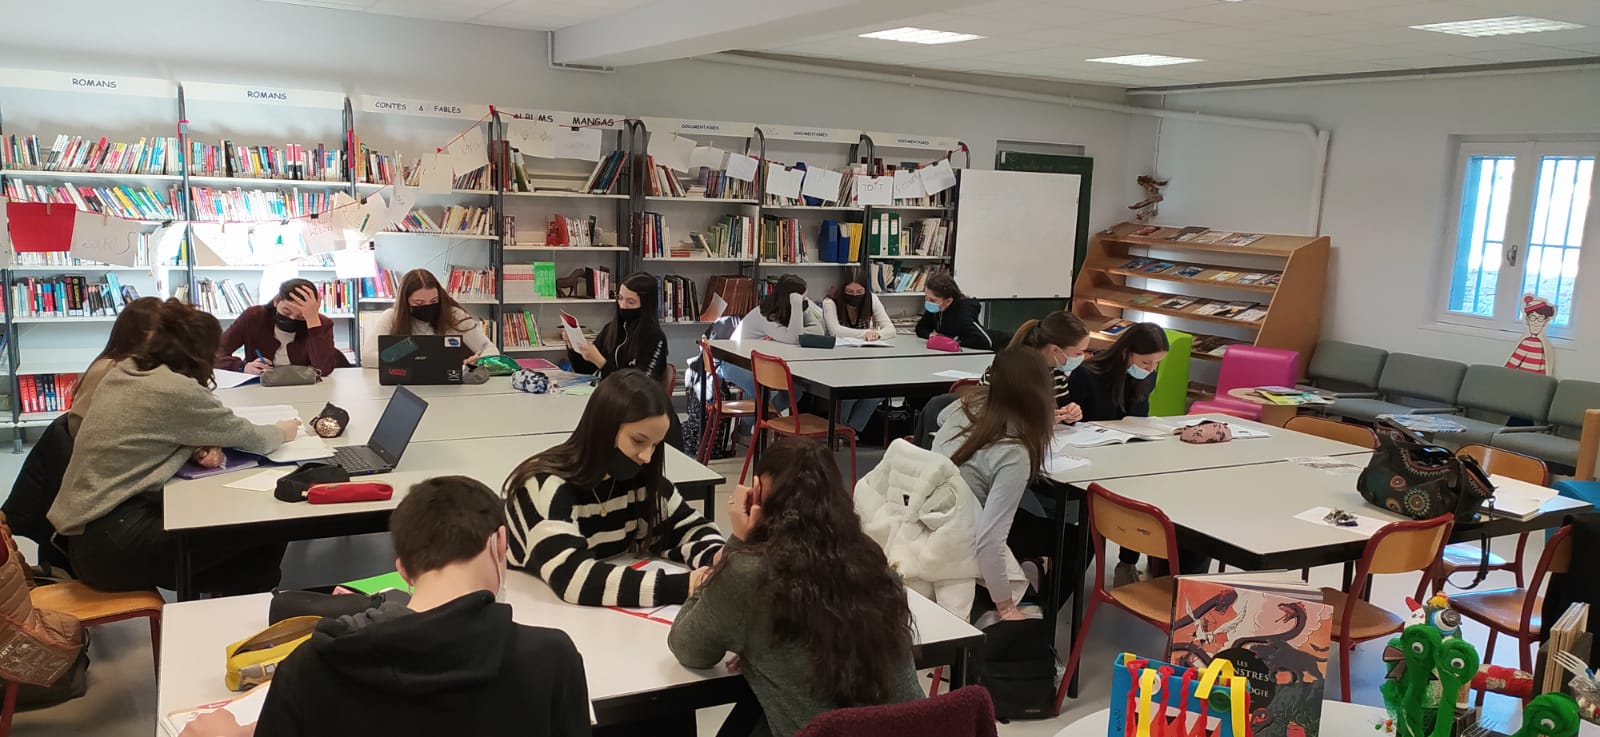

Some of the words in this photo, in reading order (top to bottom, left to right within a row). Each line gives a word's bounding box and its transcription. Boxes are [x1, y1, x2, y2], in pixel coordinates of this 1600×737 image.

[72, 78, 117, 88] ROMANS
[247, 90, 287, 100] ROMANS
[375, 101, 407, 111] CONTES
[433, 105, 462, 114] FABLES
[572, 116, 614, 127] MANGAS
